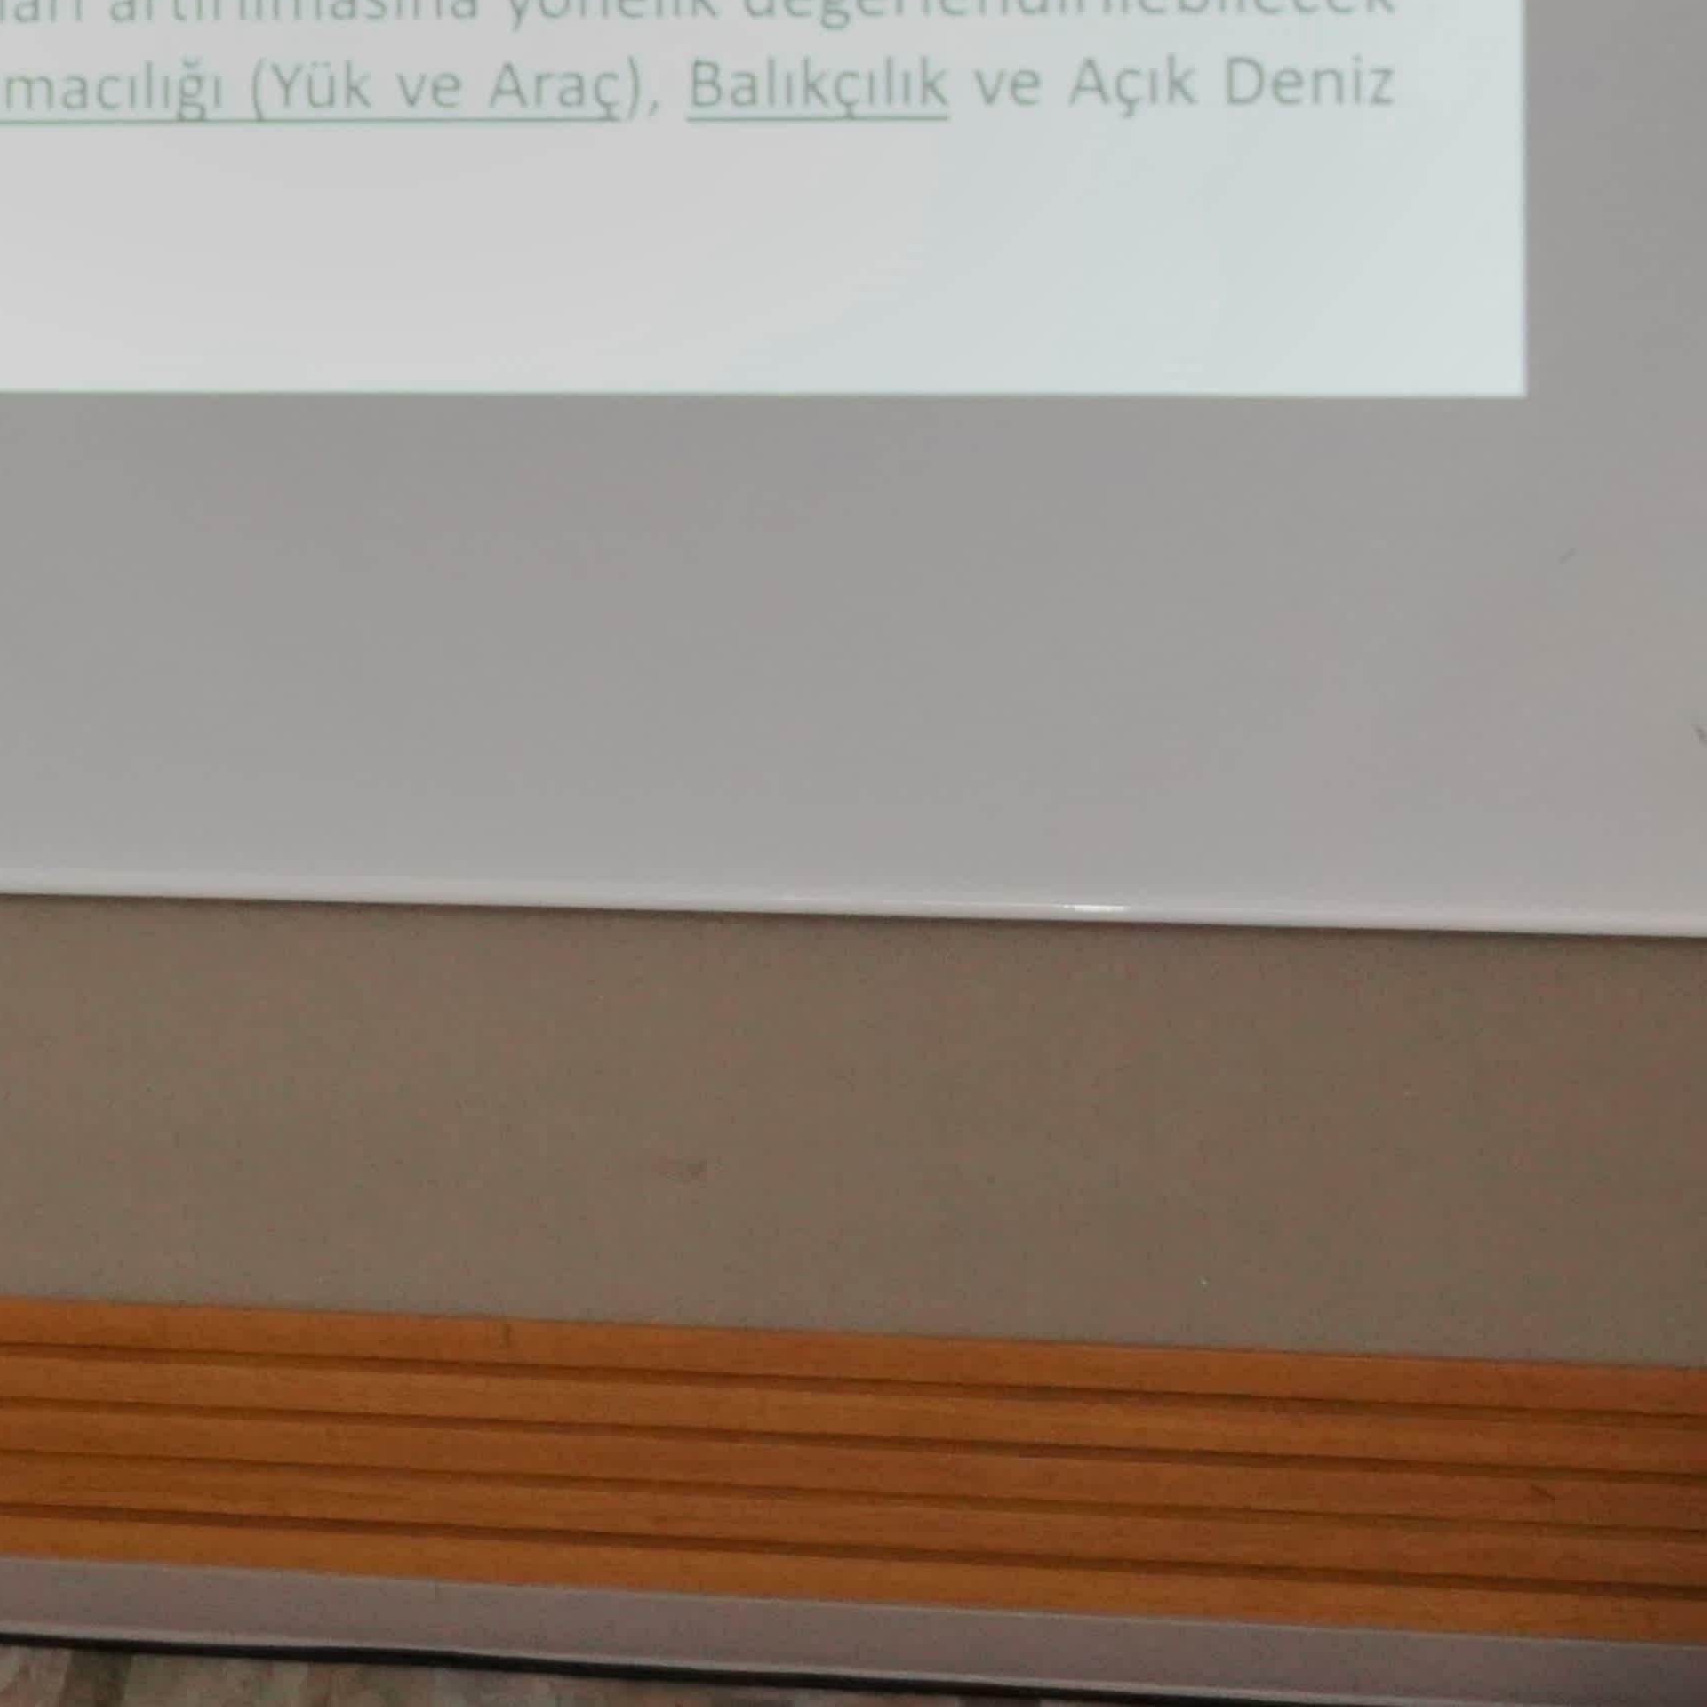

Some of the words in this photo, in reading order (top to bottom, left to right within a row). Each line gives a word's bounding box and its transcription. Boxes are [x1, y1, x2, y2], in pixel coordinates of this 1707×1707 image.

[250, 59, 372, 118] (Yük
[396, 72, 463, 110] ve
[490, 58, 660, 122] Araç),
[687, 56, 949, 120] Balıkçılık
[974, 68, 1043, 108] ve
[1068, 53, 1197, 119] Açık
[1225, 54, 1395, 107] Deniz
